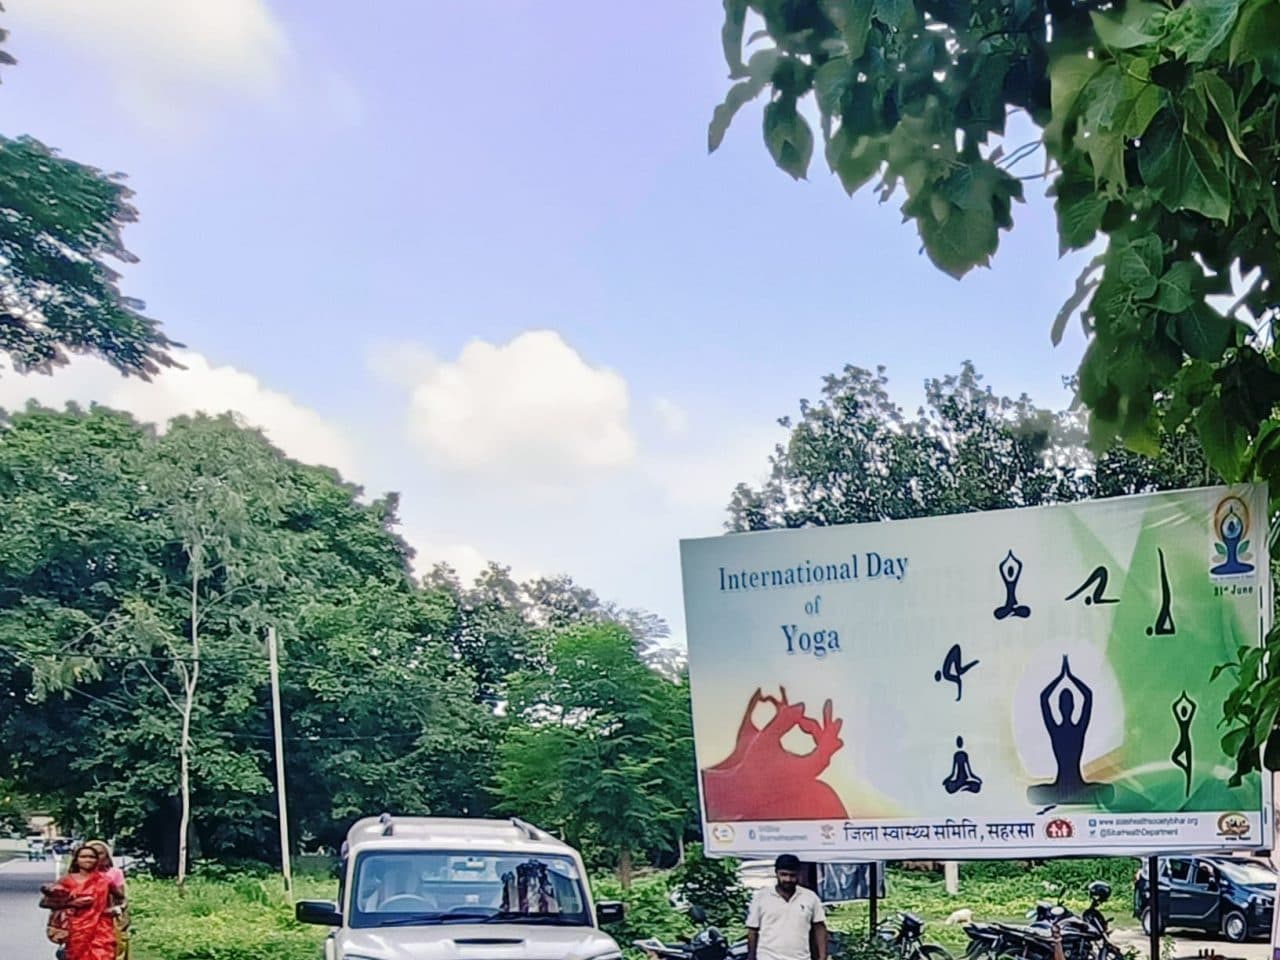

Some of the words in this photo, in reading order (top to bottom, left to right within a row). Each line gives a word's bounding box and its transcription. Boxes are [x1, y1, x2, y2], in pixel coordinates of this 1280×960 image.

[718, 554, 859, 590] International
[866, 552, 909, 580] Day
[804, 595, 822, 615] of
[781, 624, 841, 656] Yoga
[843, 822, 878, 841] जिला
[881, 825, 930, 842] स्वास्थ्य
[986, 823, 1035, 841] सहरसा
